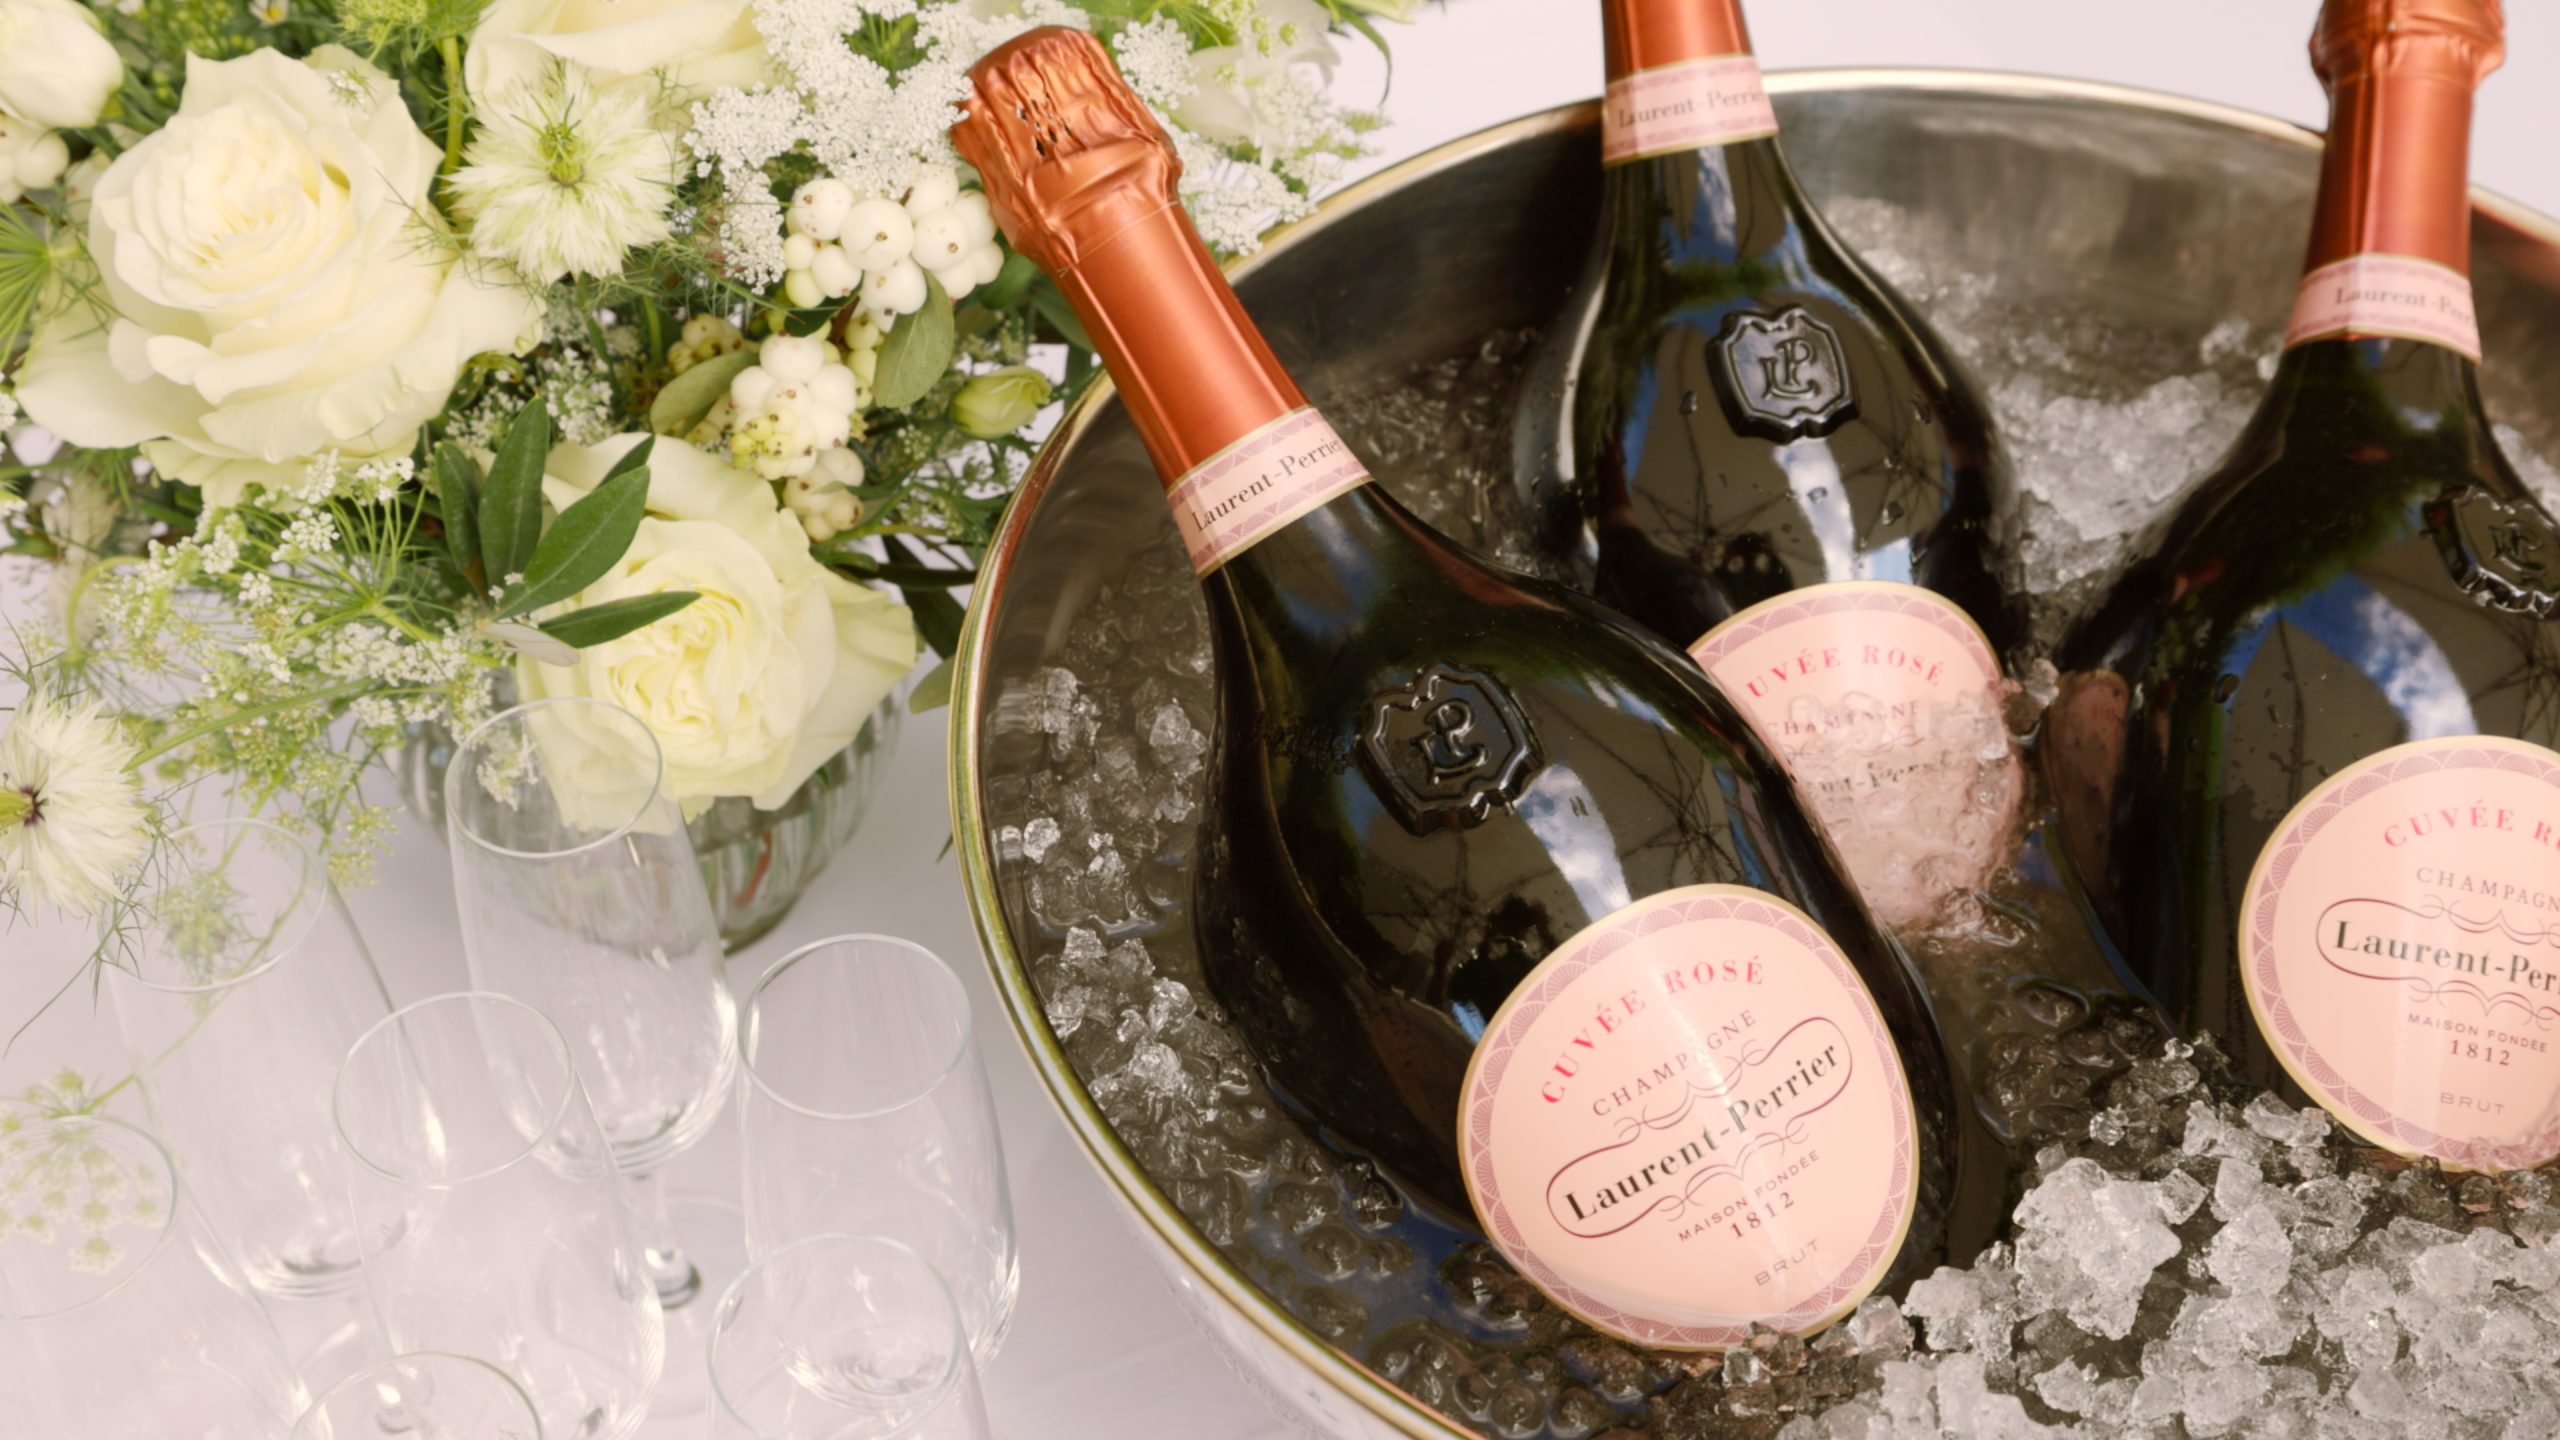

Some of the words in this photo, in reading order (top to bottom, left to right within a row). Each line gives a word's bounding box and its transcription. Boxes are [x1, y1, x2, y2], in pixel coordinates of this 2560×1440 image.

[1746, 647, 1840, 697] UVÉE
[1863, 645, 1944, 686] ROSÉ
[2384, 799, 2514, 847] CUVÉE
[2533, 820, 2560, 855] R
[2334, 919, 2560, 995] Laurent-Per
[1541, 989, 1646, 1104] CUVÉE
[1663, 955, 1765, 994] ROSÉ
[2408, 1013, 2479, 1037] MAISON
[2487, 1029, 2548, 1053] FONDÉE
[2450, 1039, 2511, 1067] 1812
[1592, 1010, 1757, 1117] CHAMPAGNE
[2440, 1092, 2506, 1115] BRUT
[1563, 1043, 1839, 1224] Laurent-Perrier
[1678, 1198, 1749, 1242] MAISON
[1754, 1149, 1820, 1199] FONDÉE
[1729, 1191, 1795, 1240] 1812
[1753, 1238, 1820, 1286] BRUT
